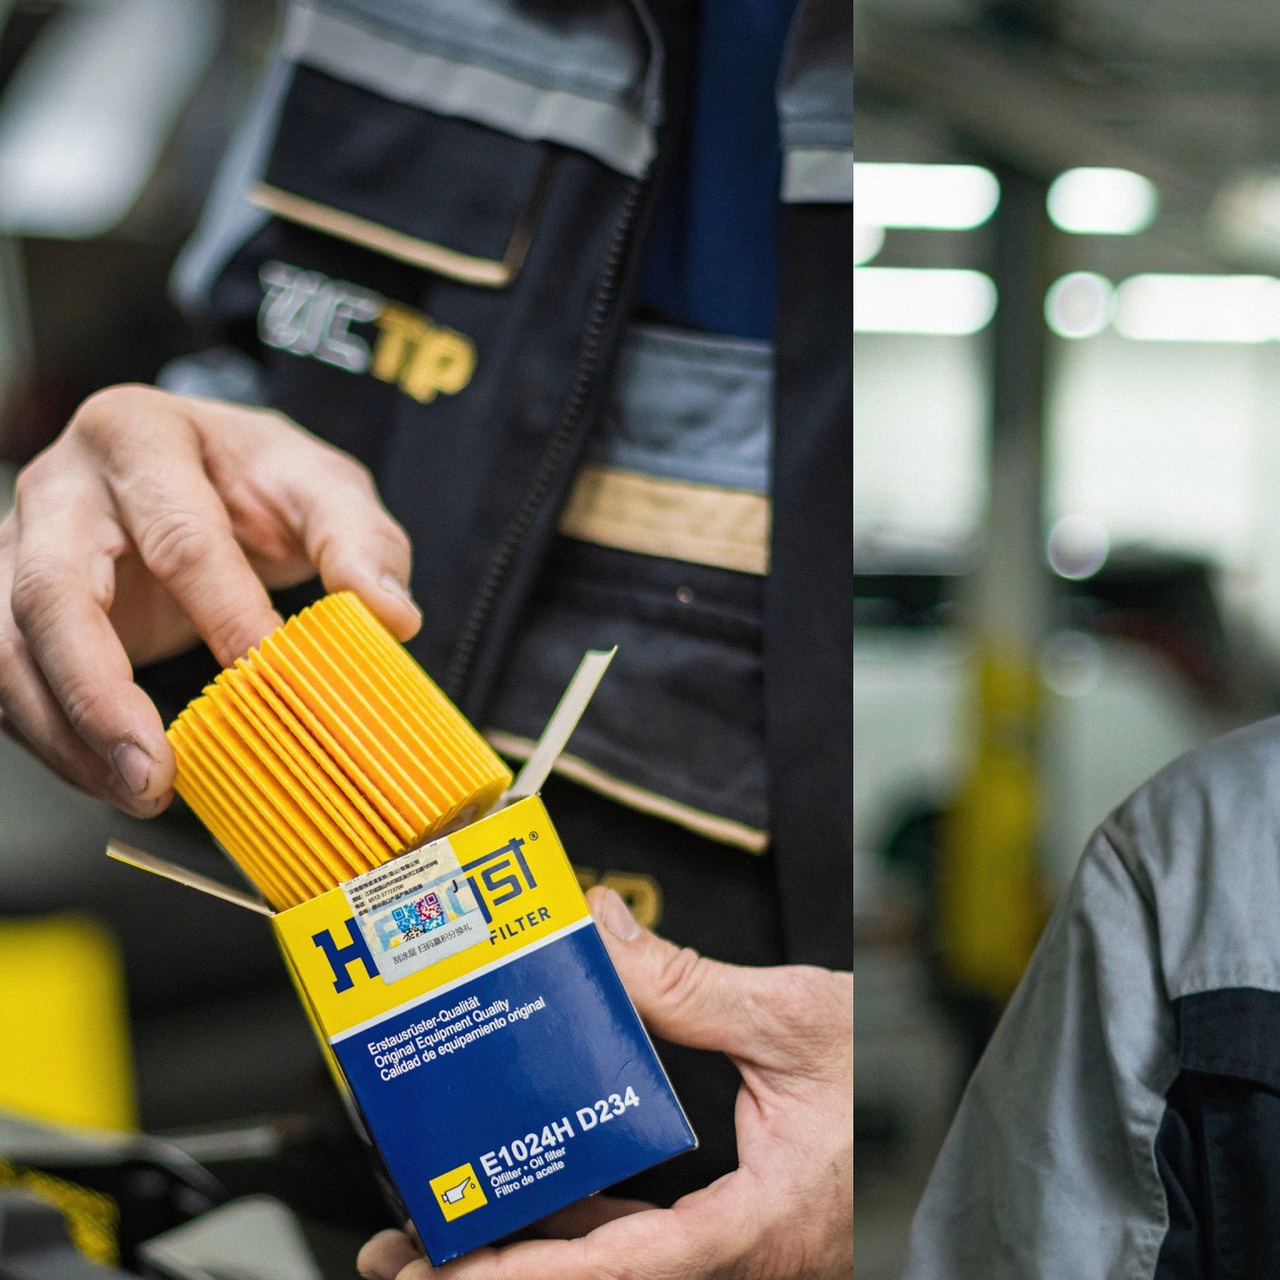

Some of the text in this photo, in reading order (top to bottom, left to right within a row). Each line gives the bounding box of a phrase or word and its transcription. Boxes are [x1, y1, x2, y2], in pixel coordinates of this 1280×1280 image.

[488, 906, 552, 946] FILTER
[366, 995, 481, 1056] Erstausrüster-Qualität
[374, 998, 511, 1069] Original Equipment Quality
[380, 996, 546, 1082] Calidad de equipamiento original
[479, 1085, 640, 1177] E1024H D234
[528, 1156, 545, 1170] Oil
[544, 1146, 567, 1163] filter
[494, 1159, 565, 1198] Filtro de aceite
